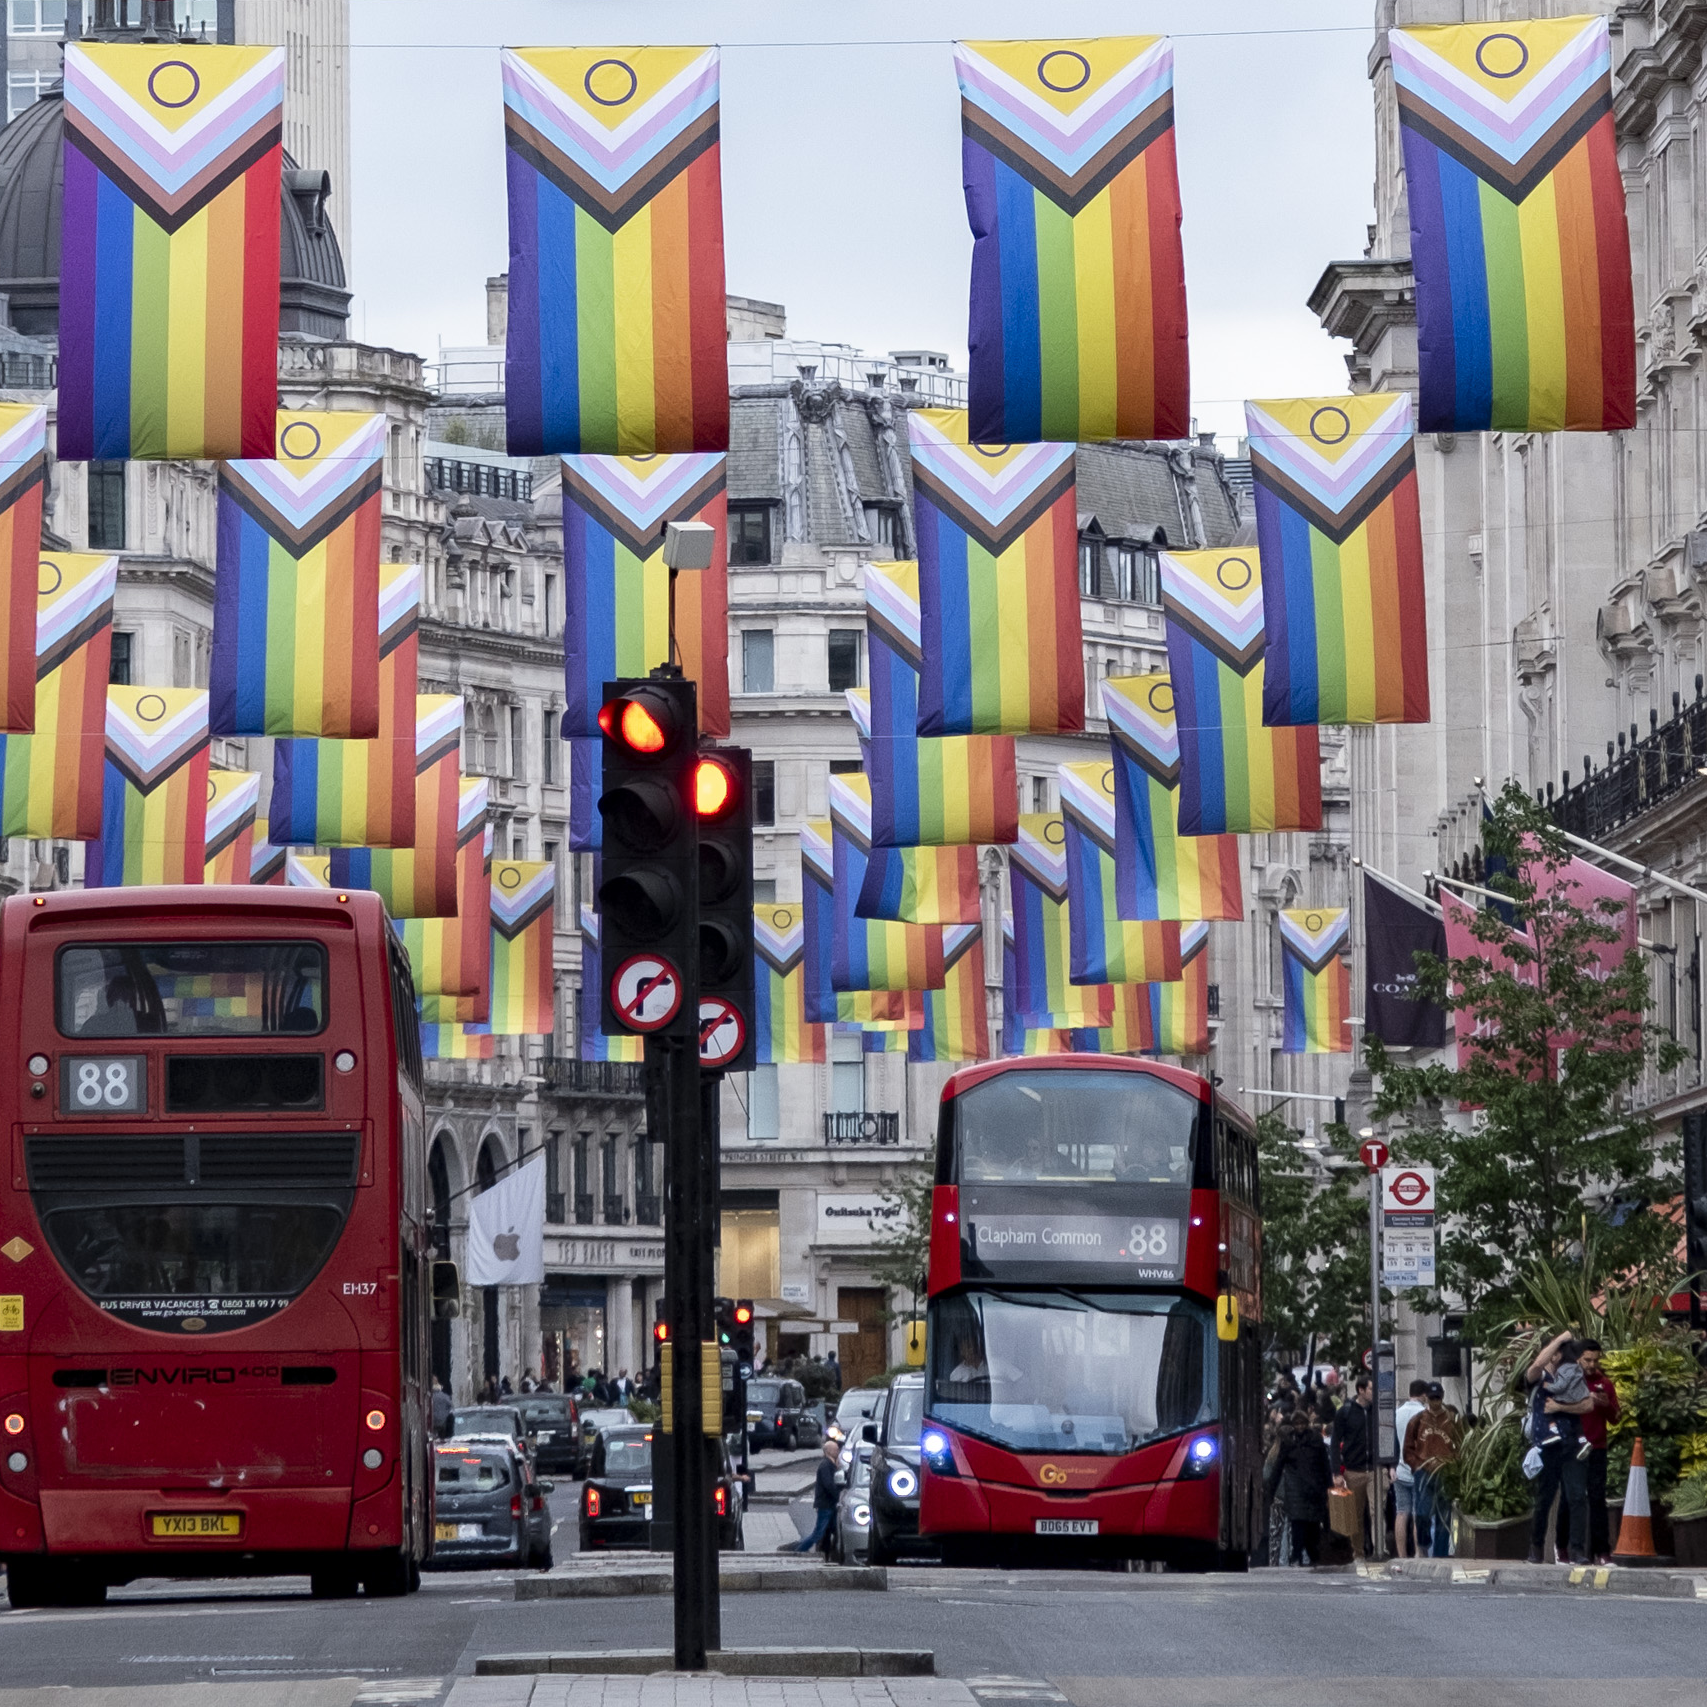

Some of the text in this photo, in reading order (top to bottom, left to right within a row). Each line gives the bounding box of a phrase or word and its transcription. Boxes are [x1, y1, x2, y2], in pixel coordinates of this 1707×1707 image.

[76, 1062, 129, 1106] 88
[1366, 1145, 1383, 1165] T
[825, 1204, 902, 1218] Onitsuka Tiger
[978, 1224, 1168, 1256] Clapham Common 88
[583, 1242, 616, 1265] BAKER
[1138, 1268, 1175, 1279] WHV86
[342, 1282, 378, 1295] EH37
[100, 1299, 289, 1310] BUS DRIVER VACANCIES 0800 38 99 7 99
[109, 1366, 280, 1386] ENVIRO 400
[163, 1516, 230, 1532] YX13 BKL
[1072, 1521, 1094, 1533] EVT
